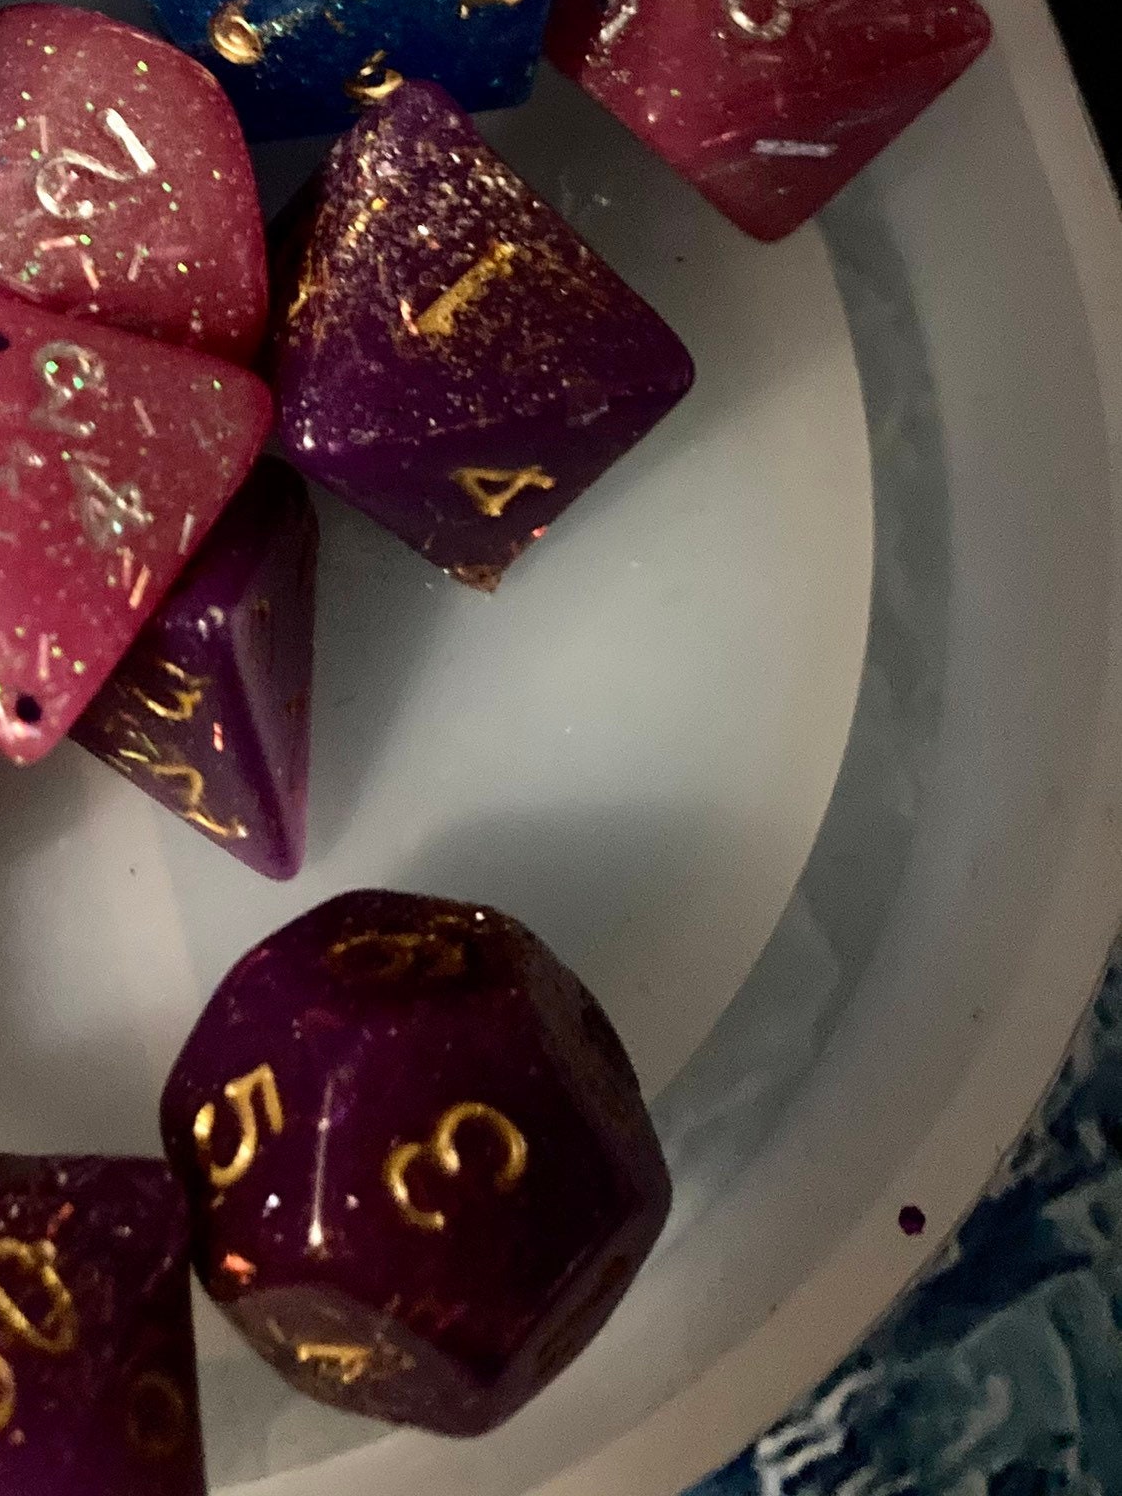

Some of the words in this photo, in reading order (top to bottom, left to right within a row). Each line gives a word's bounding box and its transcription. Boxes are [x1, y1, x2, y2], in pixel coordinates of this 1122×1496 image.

[451, 463, 557, 517] 4
[193, 1063, 285, 1187] 5
[384, 1102, 529, 1230] 3
